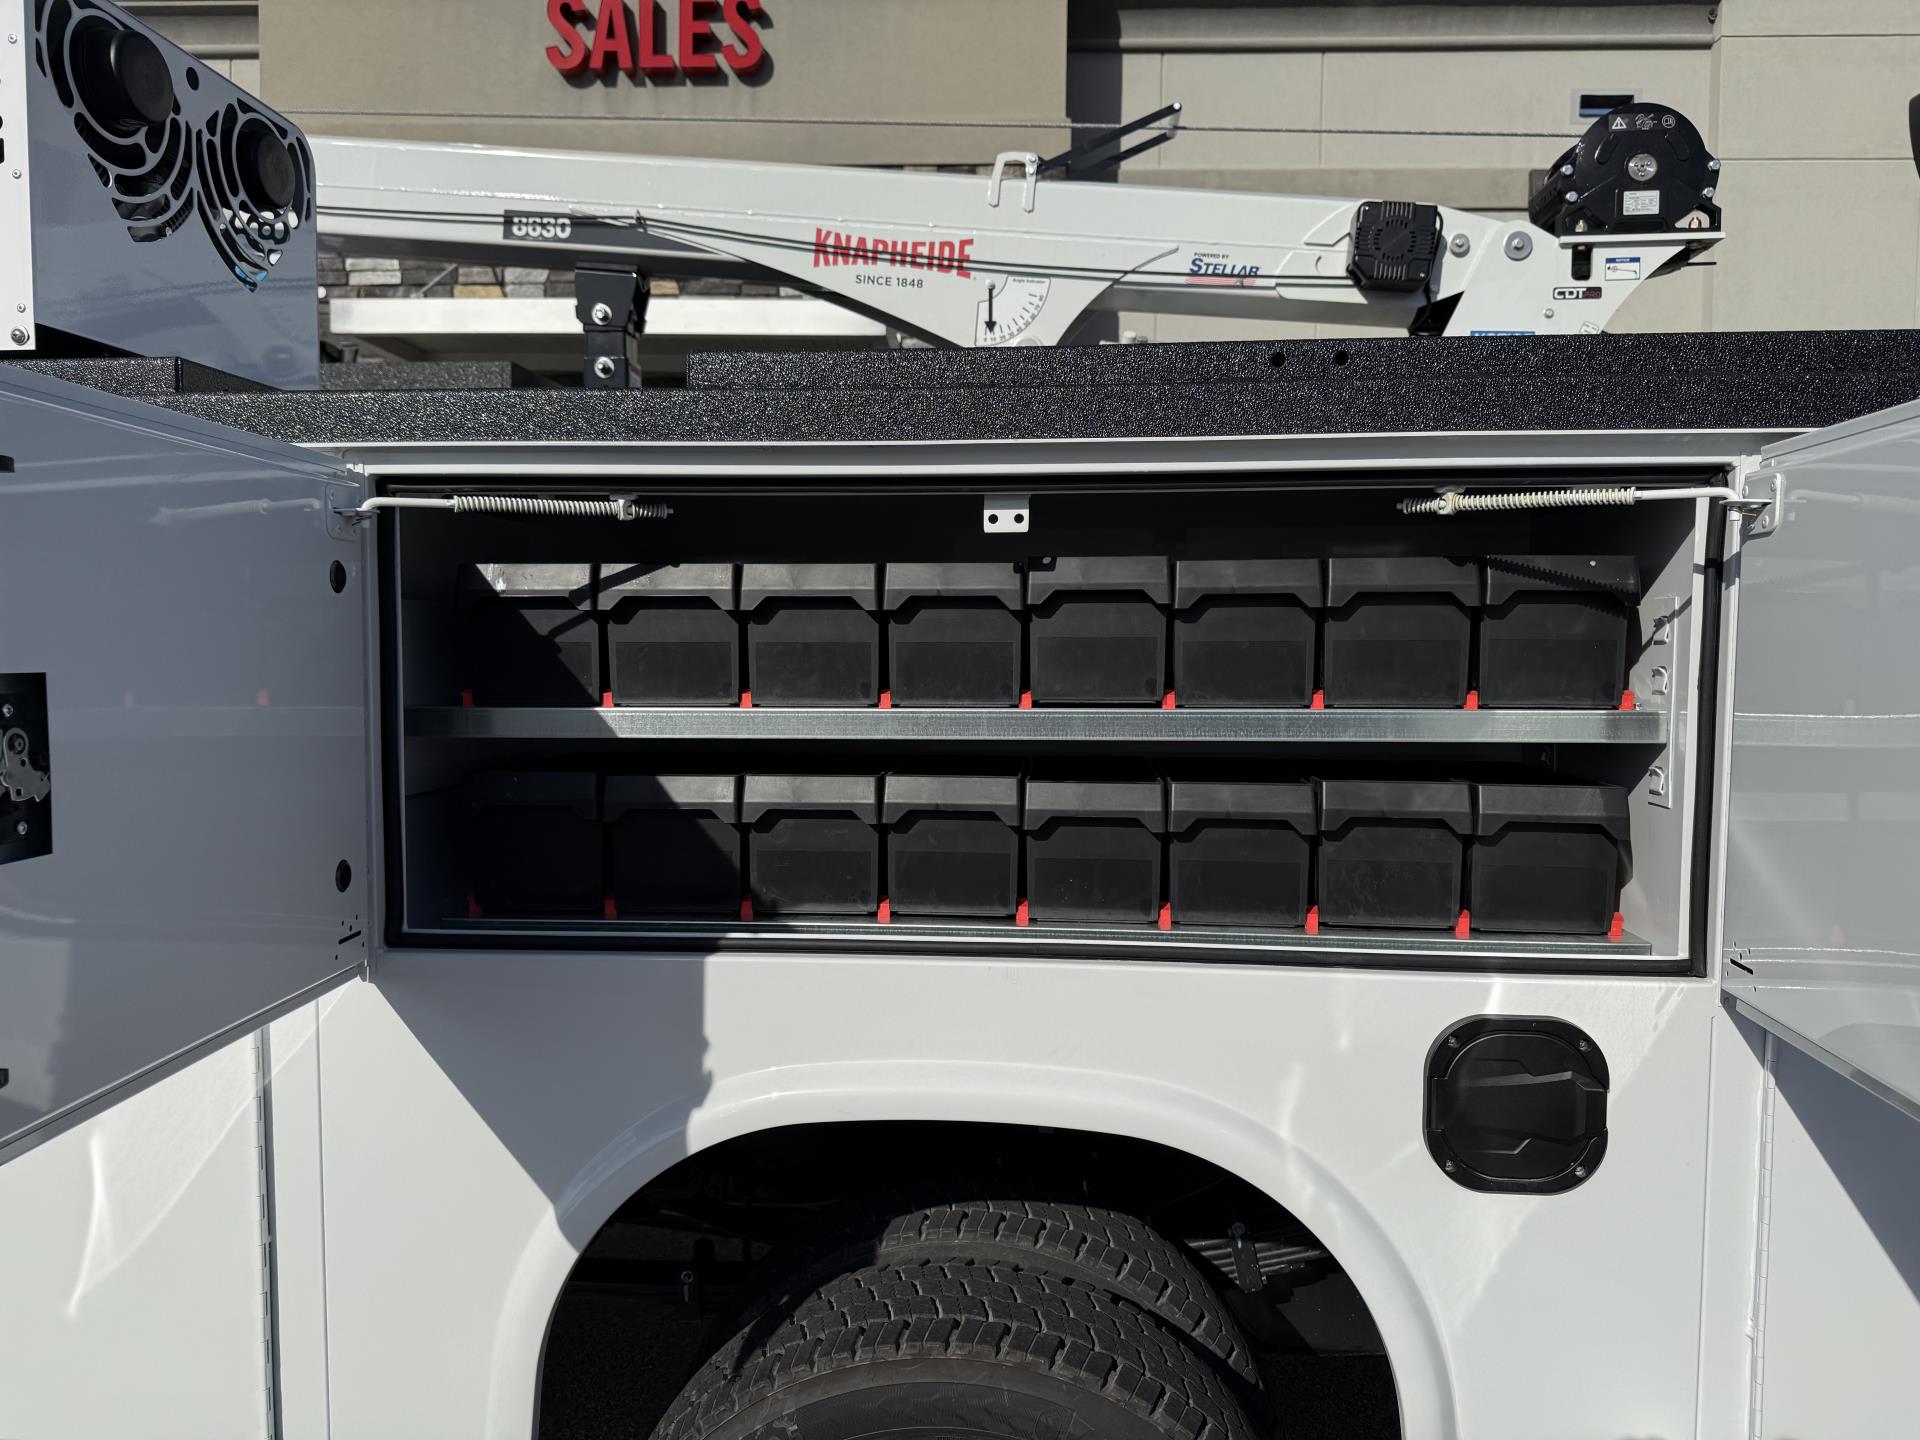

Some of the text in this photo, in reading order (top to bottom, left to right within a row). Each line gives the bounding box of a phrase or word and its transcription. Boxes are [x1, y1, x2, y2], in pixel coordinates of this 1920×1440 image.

[545, 0, 762, 72] SALES
[511, 216, 572, 239] 8630
[813, 226, 974, 280] KNAPHEIDE
[855, 274, 924, 289] SINCE 1848
